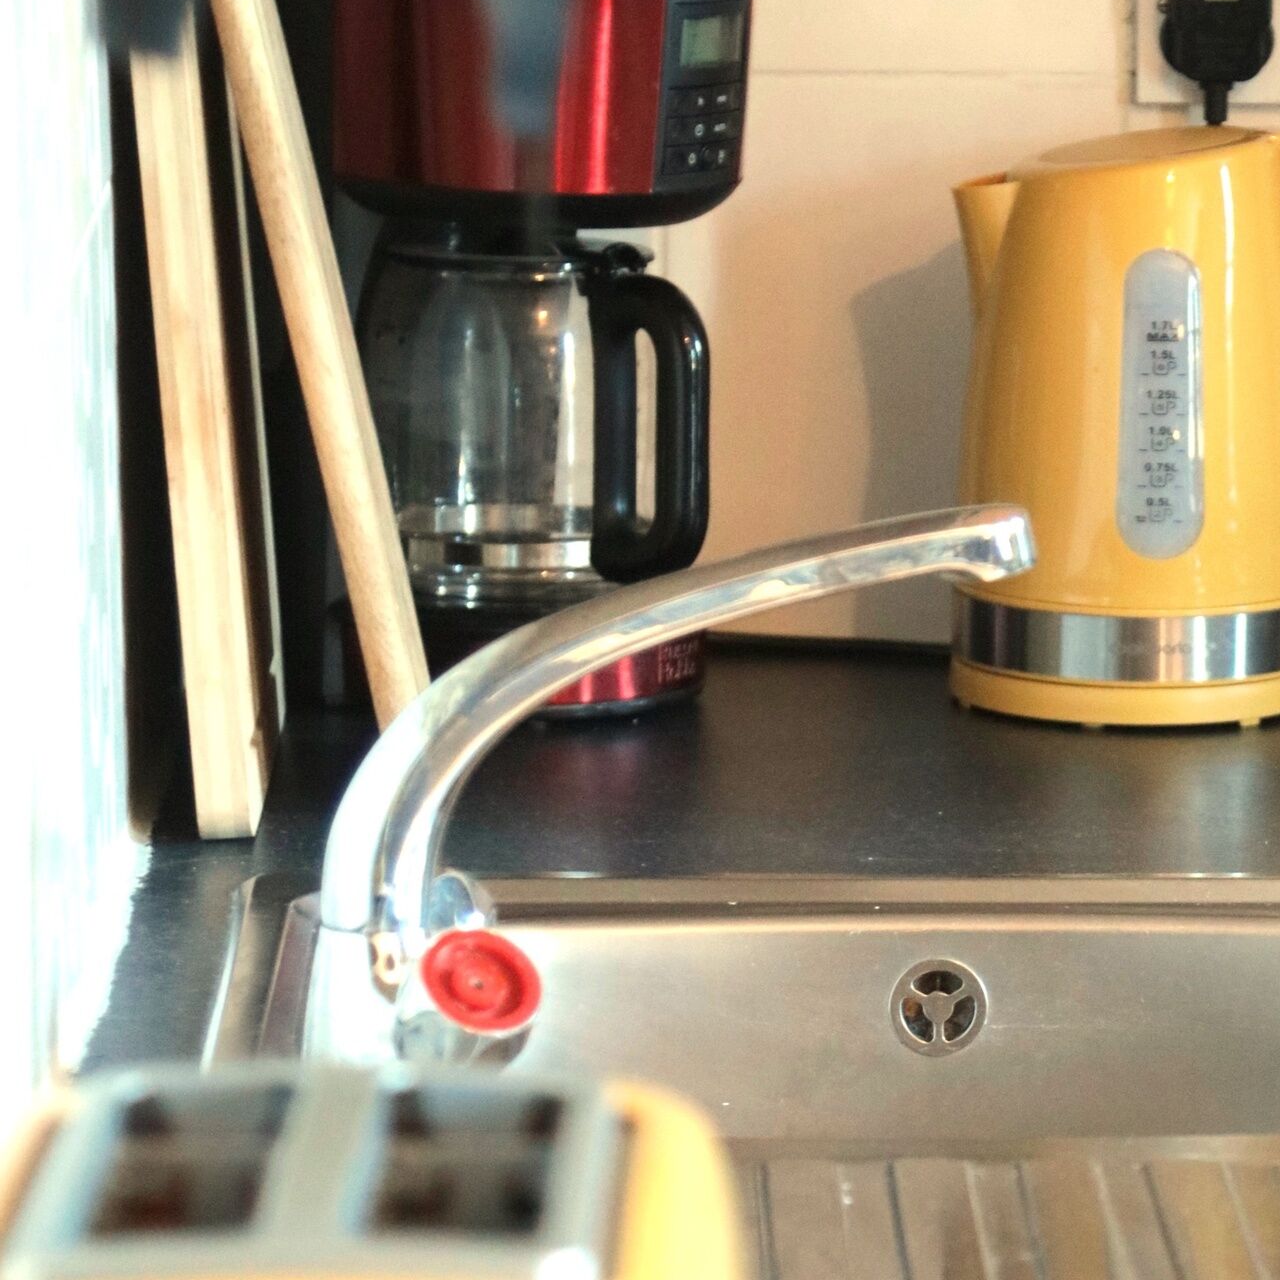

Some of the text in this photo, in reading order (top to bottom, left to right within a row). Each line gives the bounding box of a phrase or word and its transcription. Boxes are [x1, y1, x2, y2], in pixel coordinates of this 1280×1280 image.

[1152, 321, 1178, 331] 1.7L
[1151, 350, 1176, 360] 1.5L
[1146, 390, 1180, 400] 1.25L
[1149, 426, 1174, 436] 1.0L
[1144, 462, 1179, 472] 0.75L
[1146, 497, 1172, 506] 0.5L
